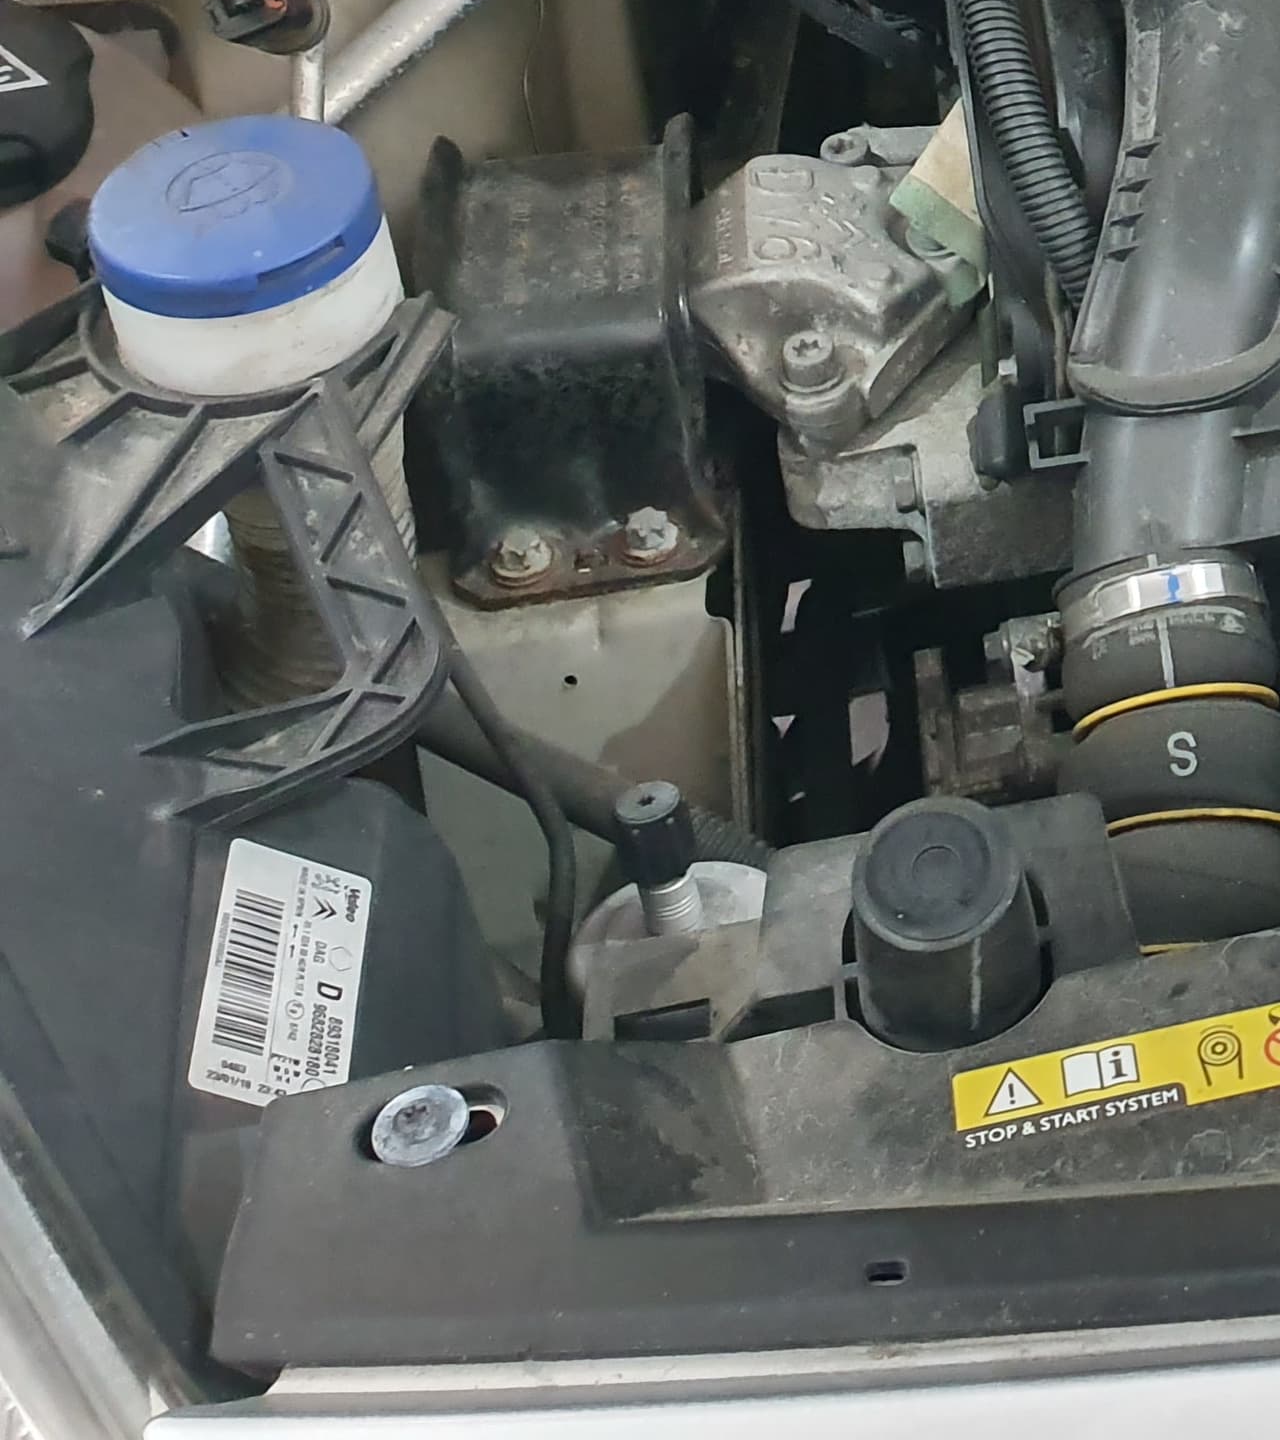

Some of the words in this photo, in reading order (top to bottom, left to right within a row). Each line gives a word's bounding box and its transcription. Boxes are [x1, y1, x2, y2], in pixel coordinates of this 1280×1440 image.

[1167, 731, 1198, 777] S
[345, 887, 362, 923] Valeo
[312, 941, 328, 965] DAG
[317, 981, 343, 1001] D
[323, 1016, 344, 1076] 89318041
[964, 1124, 1018, 1149] STOP
[1022, 1118, 1036, 1136] &
[1039, 1105, 1101, 1131] START
[1105, 1087, 1179, 1117] SYSTEM
